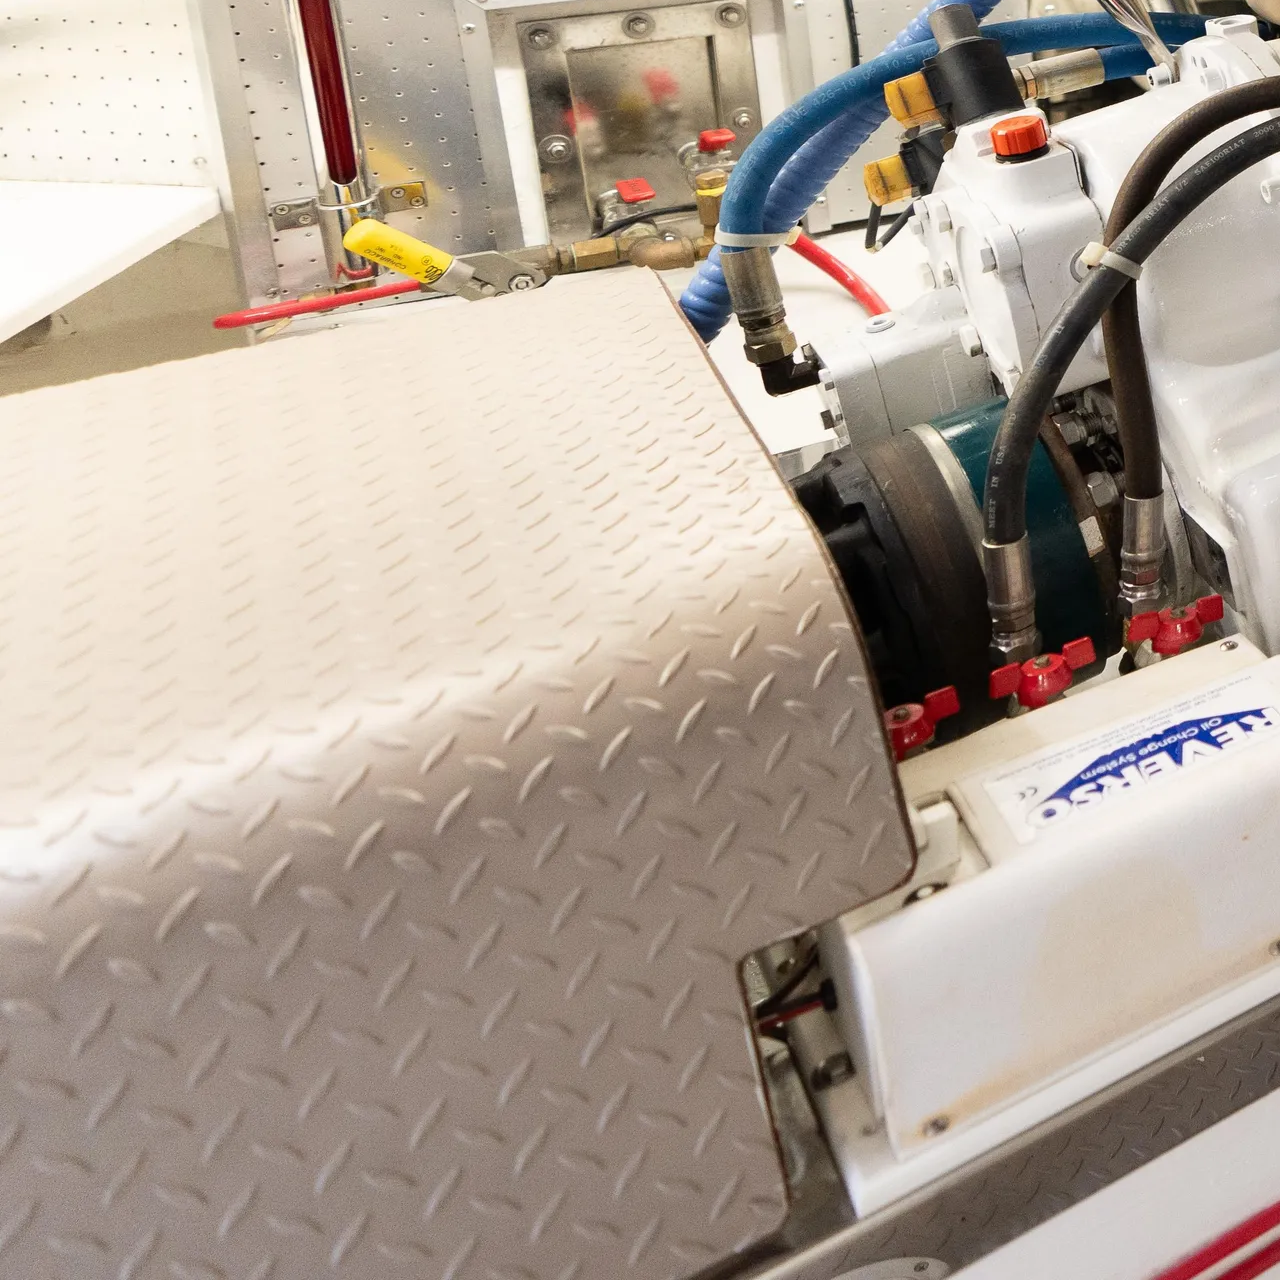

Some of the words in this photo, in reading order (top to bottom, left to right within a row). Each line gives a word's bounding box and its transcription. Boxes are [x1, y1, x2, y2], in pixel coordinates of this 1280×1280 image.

[1253, 124, 1275, 138] 2000
[990, 476, 999, 487] IN
[995, 445, 1006, 464] USA
[1199, 715, 1222, 732] Oil
[1137, 724, 1199, 757] Change
[1078, 751, 1137, 782] System
